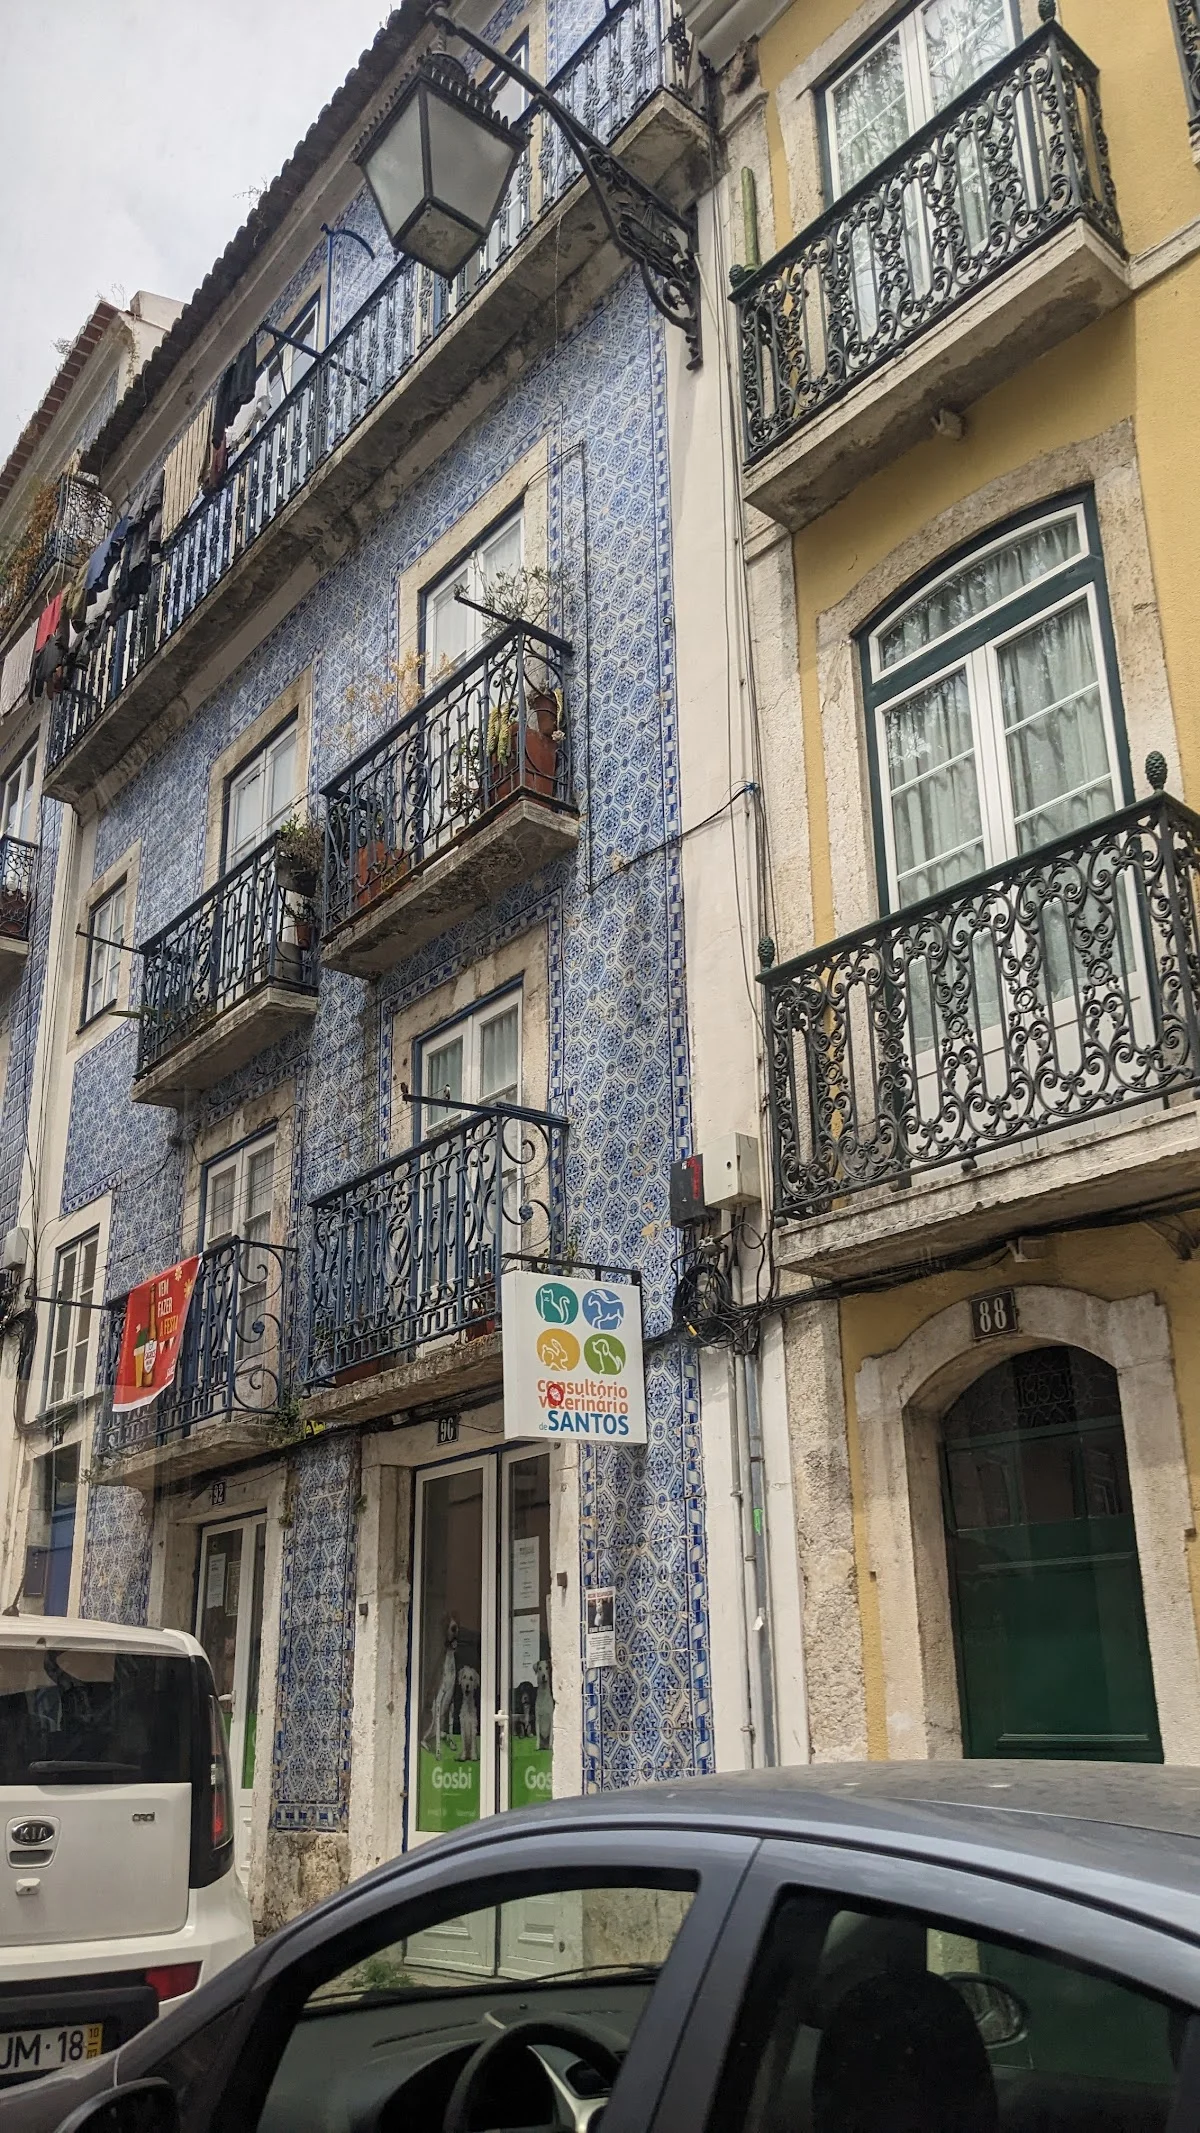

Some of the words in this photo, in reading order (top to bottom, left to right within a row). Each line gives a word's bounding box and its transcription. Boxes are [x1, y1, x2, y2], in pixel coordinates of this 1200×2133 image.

[157, 1297, 173, 1317] FAZER
[979, 1297, 1007, 1333] 88
[164, 1315, 179, 1335] FESTA
[548, 1410, 629, 1435] SANTOS
[432, 1766, 472, 1789] Gosbi
[19, 1826, 47, 1840] KIA
[89, 2027, 99, 2038] 10
